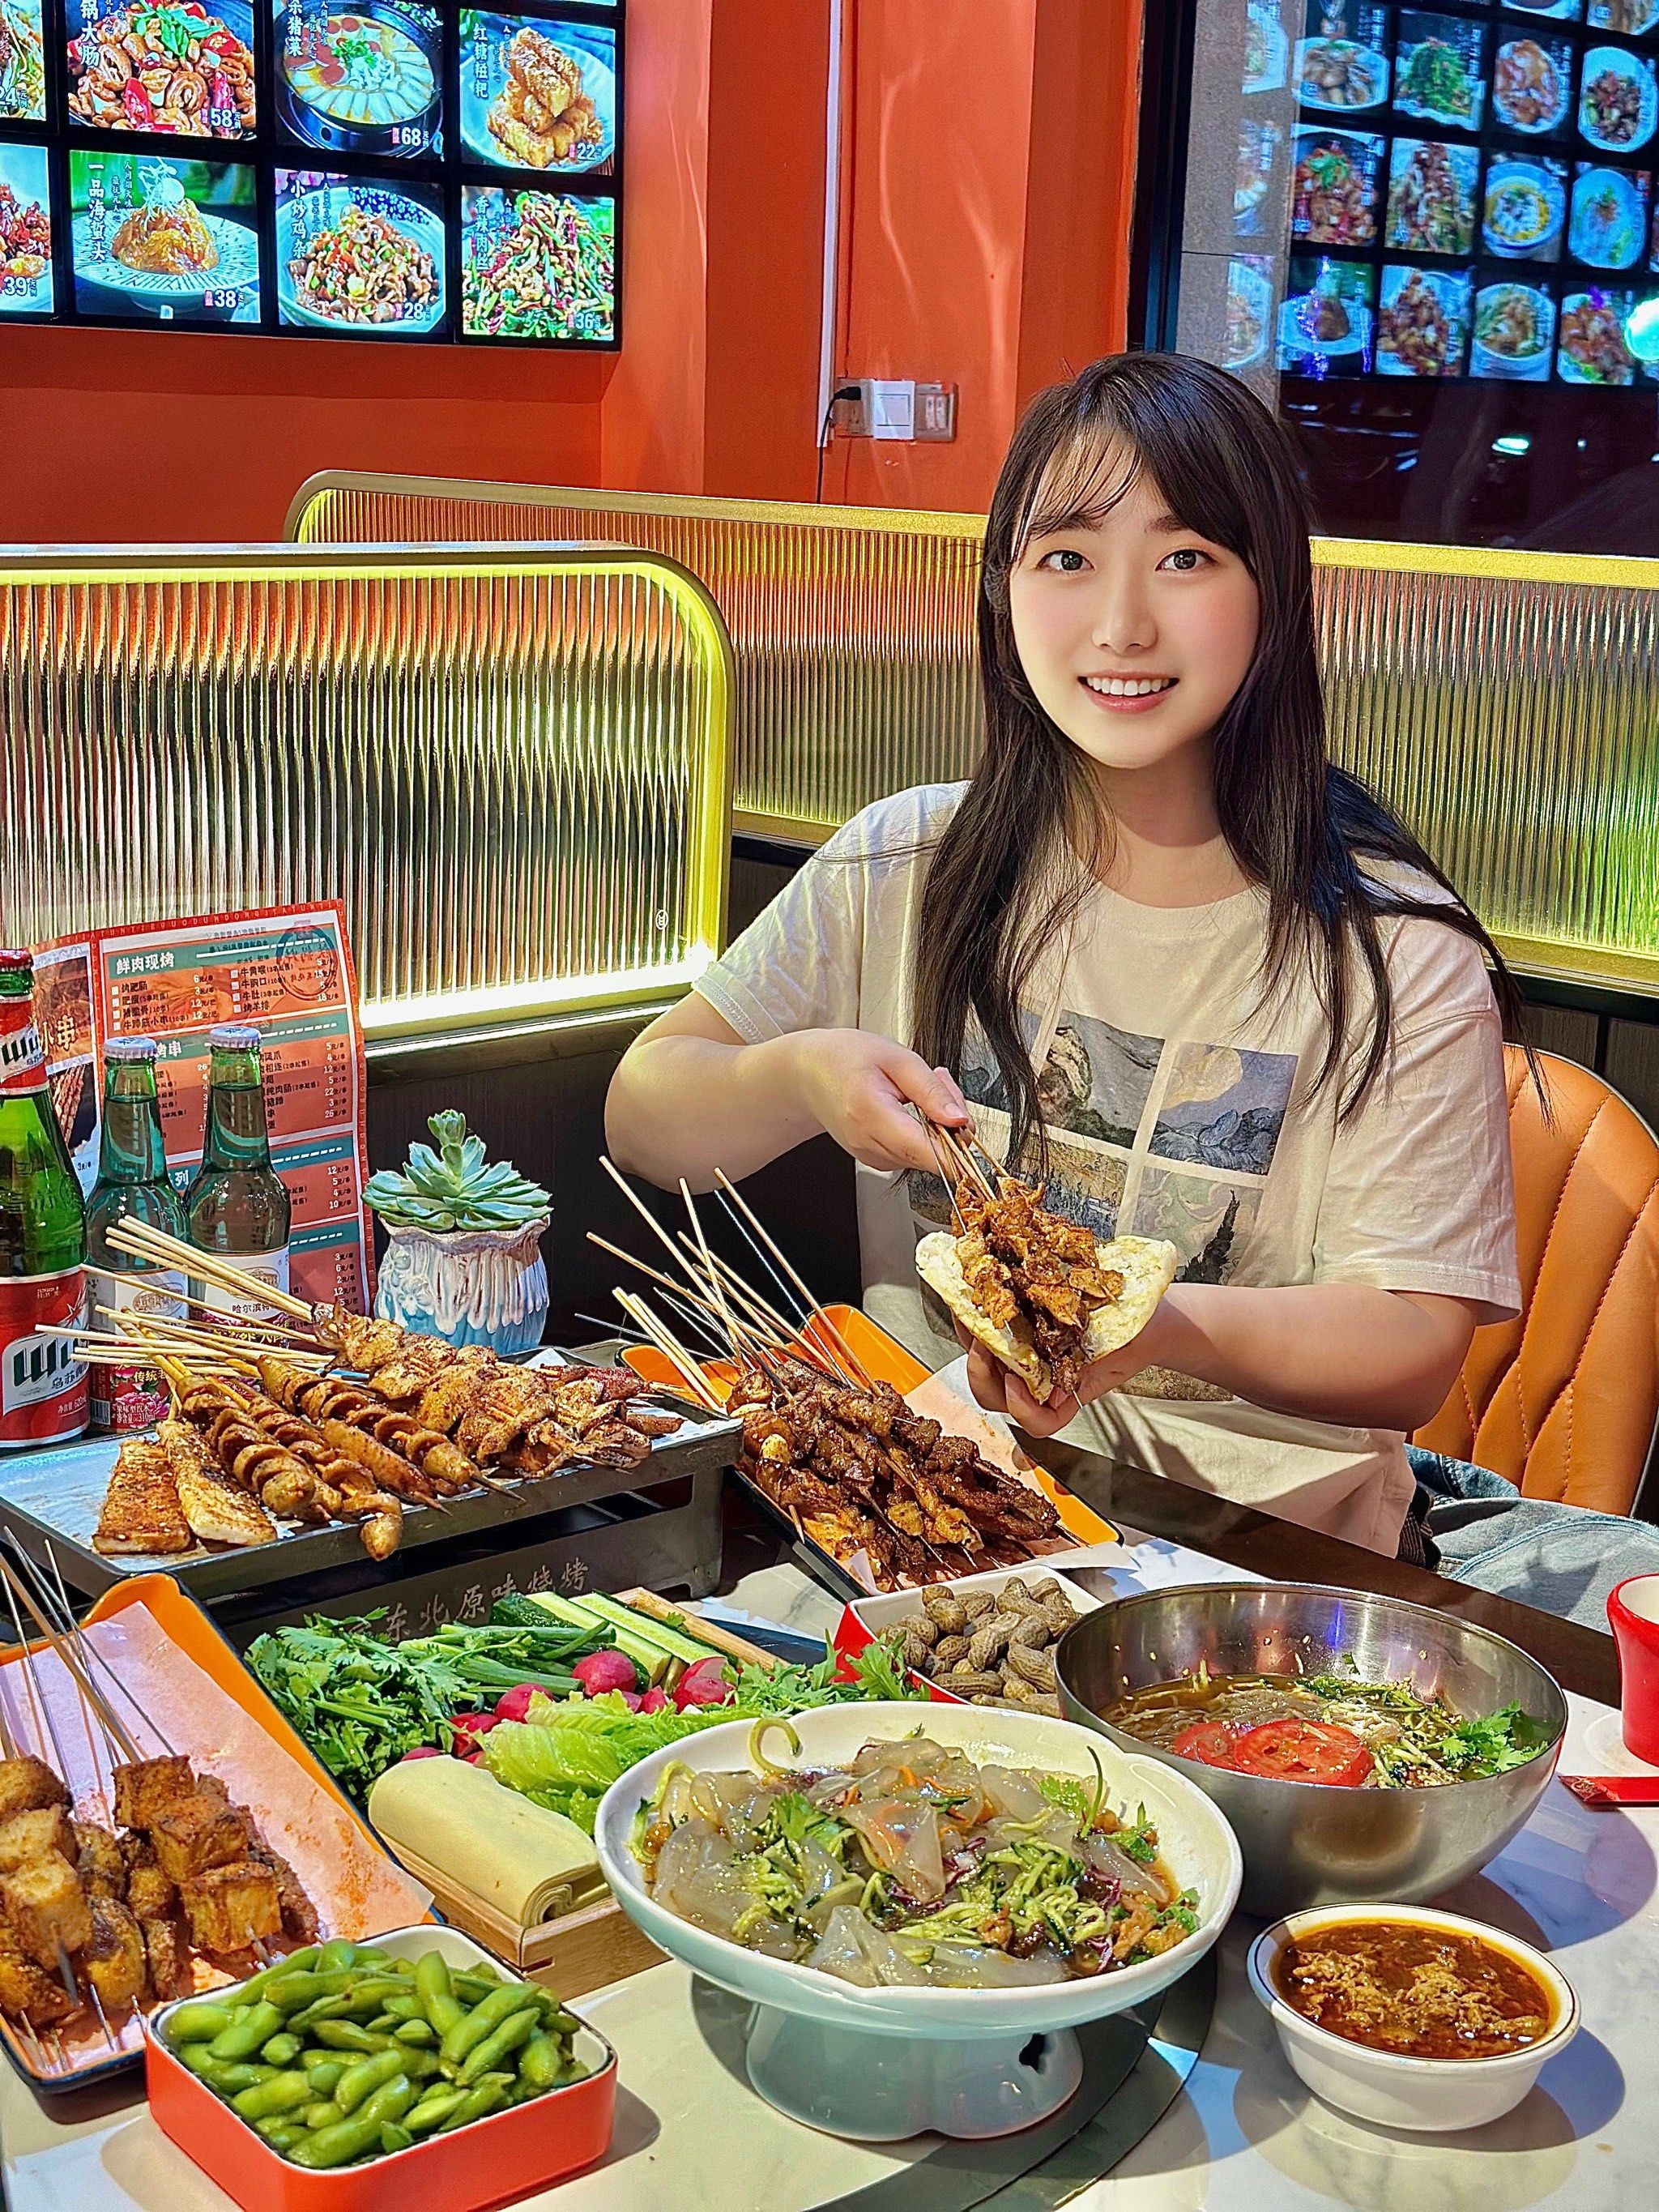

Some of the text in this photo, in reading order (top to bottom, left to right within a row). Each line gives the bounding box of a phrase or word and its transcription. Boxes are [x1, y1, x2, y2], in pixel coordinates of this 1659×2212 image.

[473, 23, 488, 98] 红糖糍粑
[211, 108, 232, 128] 58
[402, 126, 422, 146] 68
[577, 142, 595, 160] 22
[88, 164, 107, 262] 一品海蜇头
[291, 179, 307, 259] 小炒鸡杂
[475, 194, 489, 271] 香辣肉丝
[3, 275, 28, 297] 39
[215, 288, 237, 309] 38
[404, 301, 424, 321] 28
[575, 312, 594, 330] 36
[116, 951, 175, 975] 鲜肉现烤
[349, 1557, 589, 1642] 东北原味烧烤
